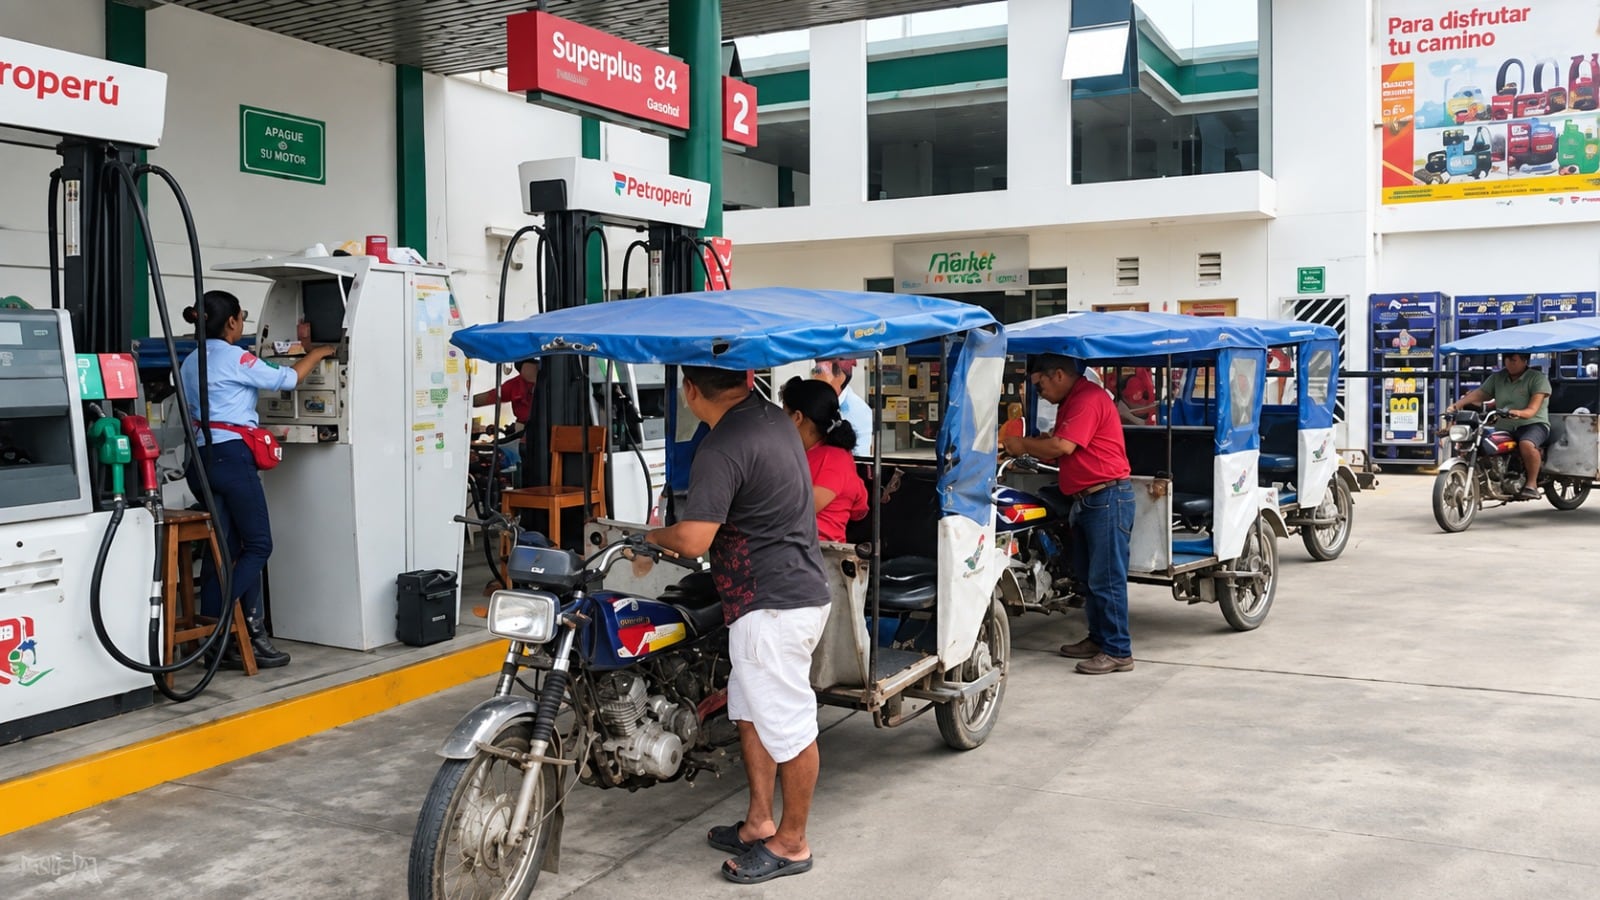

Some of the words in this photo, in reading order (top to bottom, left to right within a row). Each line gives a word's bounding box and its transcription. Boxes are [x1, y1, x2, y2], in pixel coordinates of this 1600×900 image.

[1388, 17, 1433, 35] Para
[1439, 6, 1531, 30] disfrutar
[1388, 38, 1411, 56] tu
[1416, 31, 1496, 54] camino
[552, 31, 642, 84] Superplus
[654, 65, 677, 94] 84
[647, 97, 680, 117] Gasohol
[733, 92, 750, 135] 2
[265, 126, 304, 142] APAGUE
[260, 148, 272, 160] SU
[274, 151, 306, 165] MOTOR
[627, 176, 692, 207] Petroperú
